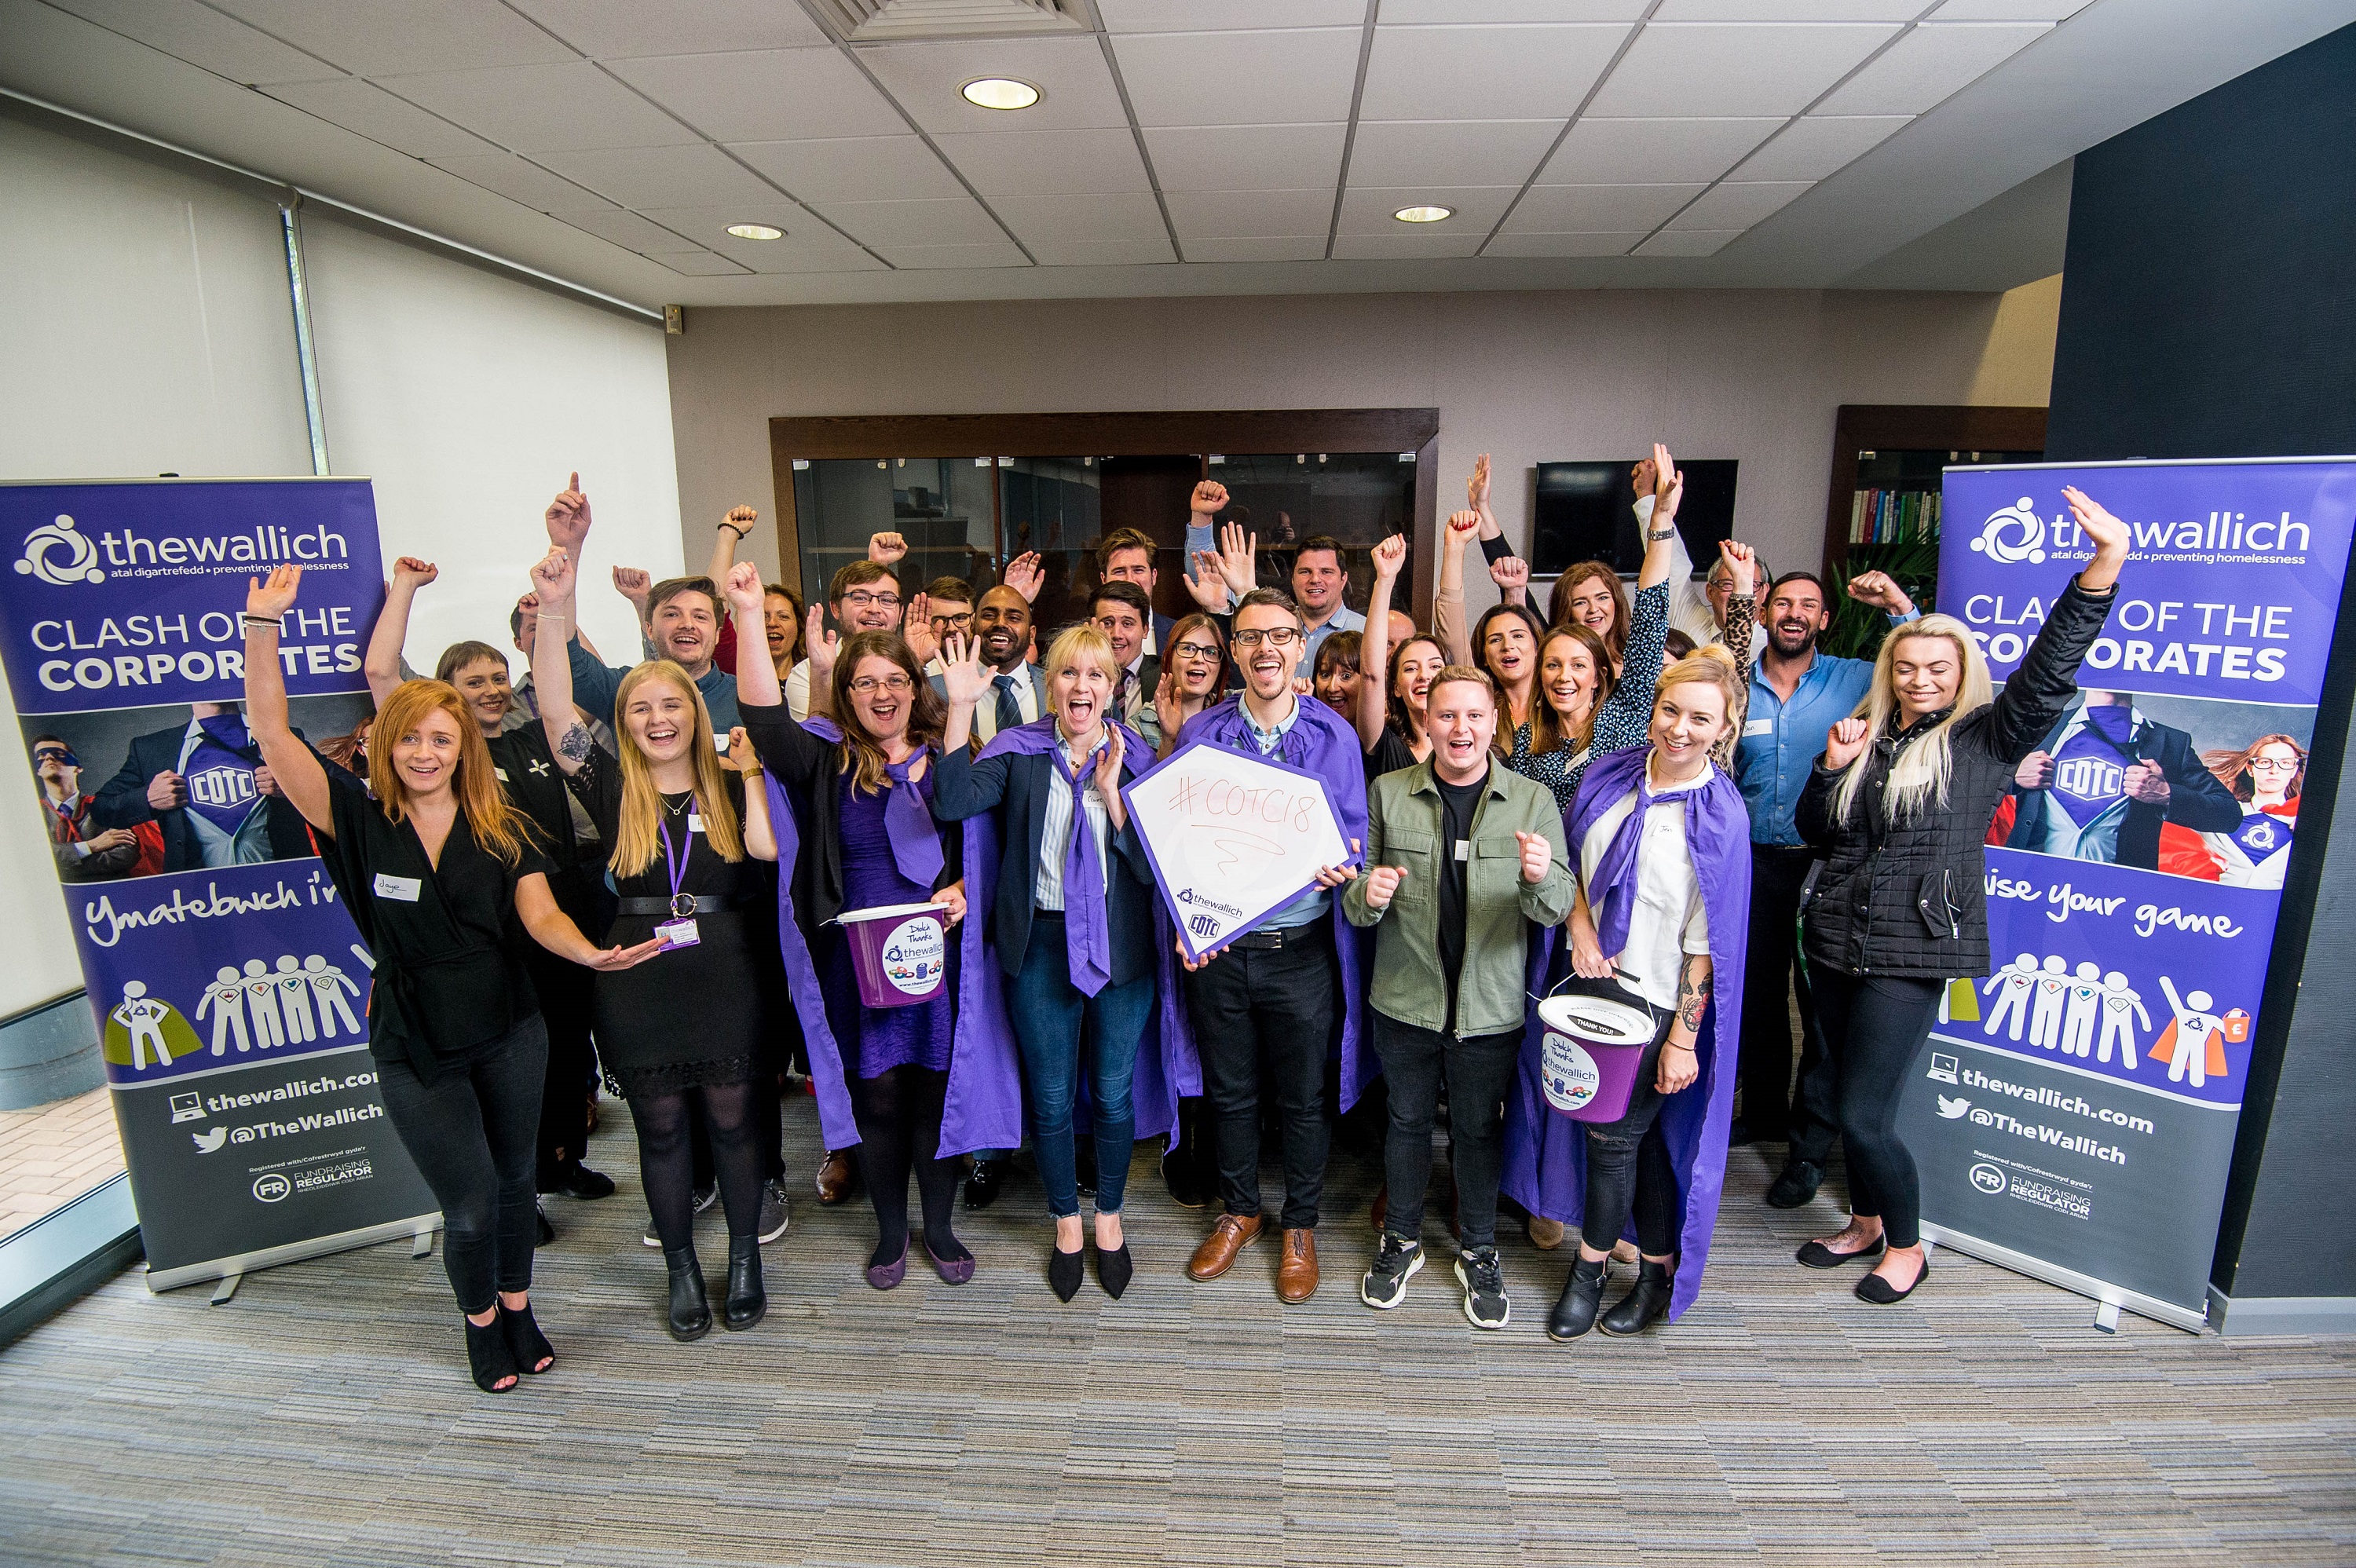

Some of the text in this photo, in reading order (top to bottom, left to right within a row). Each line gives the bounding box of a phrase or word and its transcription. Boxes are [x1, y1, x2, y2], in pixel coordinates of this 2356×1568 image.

[101, 524, 349, 566] thewallich
[2050, 511, 2310, 551] twallich
[111, 562, 349, 579] atal digartrefedd preventing helessness
[2051, 550, 2306, 565] atal digadd preventing homelessness
[31, 614, 190, 652] CLASH
[278, 607, 357, 638] THE
[2118, 599, 2184, 632] OF
[2192, 602, 2292, 639] THE
[38, 643, 362, 692] CORPORTES
[1971, 631, 2288, 682] OORATES
[193, 769, 253, 804] COTC
[2059, 760, 2120, 796] COTC
[1169, 776, 1316, 832] #COTC18
[1194, 894, 1243, 918] thewallich
[1984, 868, 2244, 938] ise your game
[906, 932, 932, 943] Thanks
[1190, 916, 1218, 937] COTC
[1576, 1018, 1614, 1036] THANK YOU!
[1547, 1057, 1596, 1080] thewallich
[1550, 1045, 1575, 1063] Thanks
[207, 1072, 379, 1112] thewallich.co
[1962, 1069, 2154, 1135] thewallich.com
[230, 1103, 384, 1145] @TheWallich
[1969, 1107, 2127, 1165] @TheWallich
[248, 1161, 285, 1173] Registered
[287, 1150, 344, 1166] with/Cofrestrwyd
[294, 1158, 371, 1180] FUNDRAISING
[295, 1166, 372, 1189] REGULATOR
[1973, 1150, 2010, 1164] Registered
[2010, 1160, 2069, 1183] with/Cofrestrwyd
[258, 1181, 286, 1197] FR
[1975, 1170, 2000, 1188] FR
[2011, 1175, 2091, 1207] FUNDRAISING
[2010, 1183, 2091, 1216] REGULATOR
[2054, 1205, 2069, 1215] CODI
[2069, 1211, 2089, 1221] ARIAN
